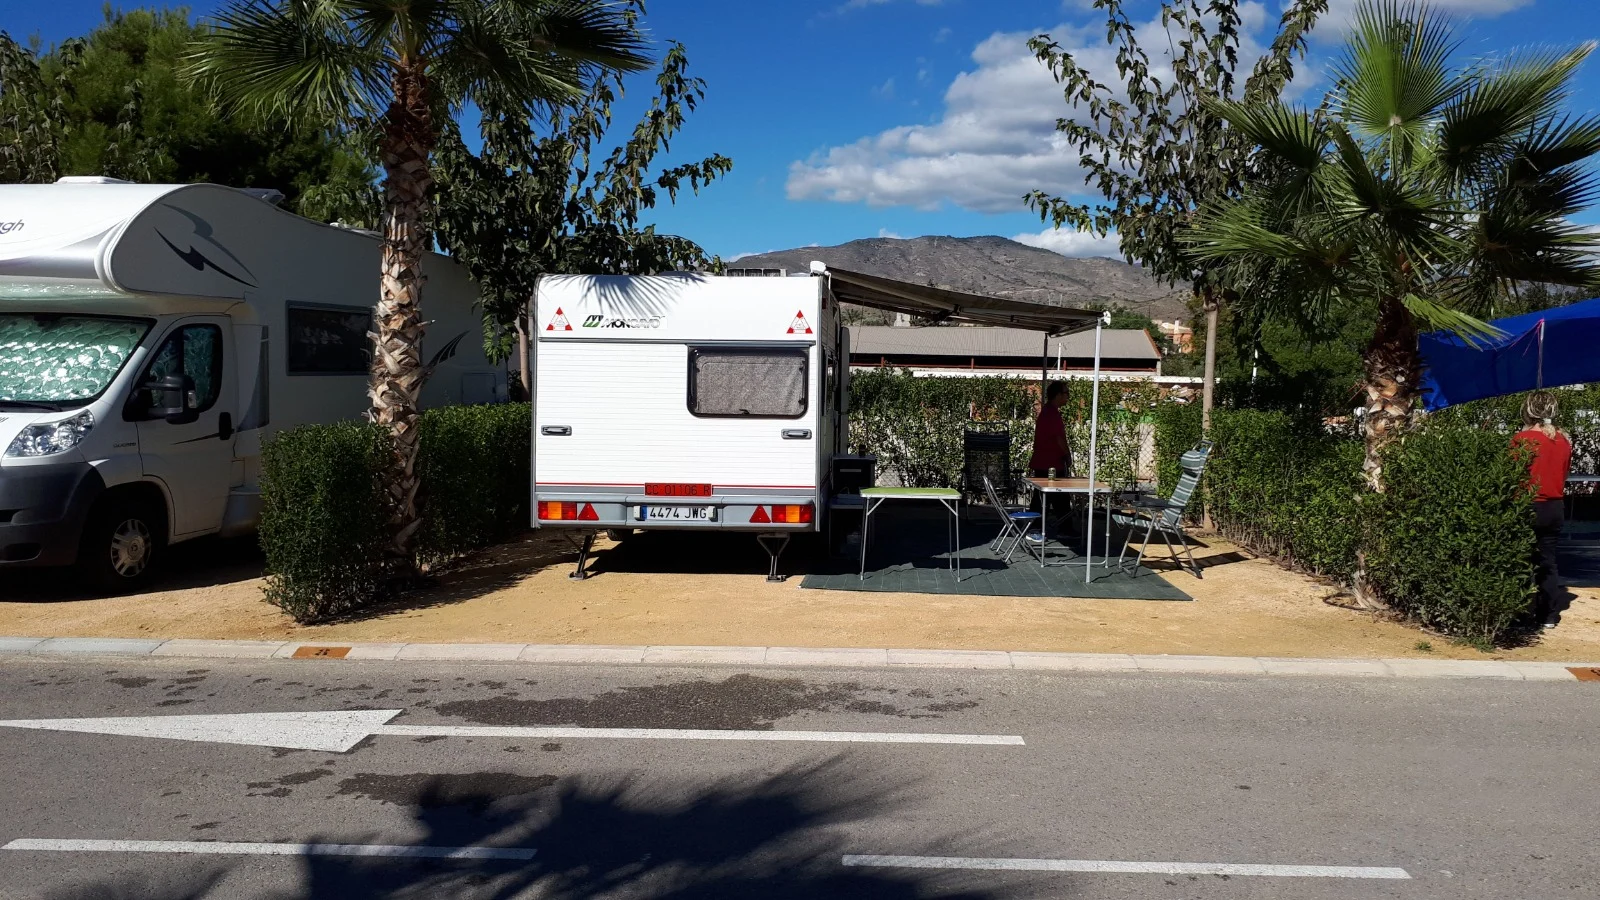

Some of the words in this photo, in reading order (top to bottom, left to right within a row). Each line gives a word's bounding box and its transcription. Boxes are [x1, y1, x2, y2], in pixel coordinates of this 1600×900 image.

[645, 484, 659, 496] CC
[703, 485, 711, 497] R
[649, 507, 680, 519] 4474
[685, 507, 707, 519] JWG
